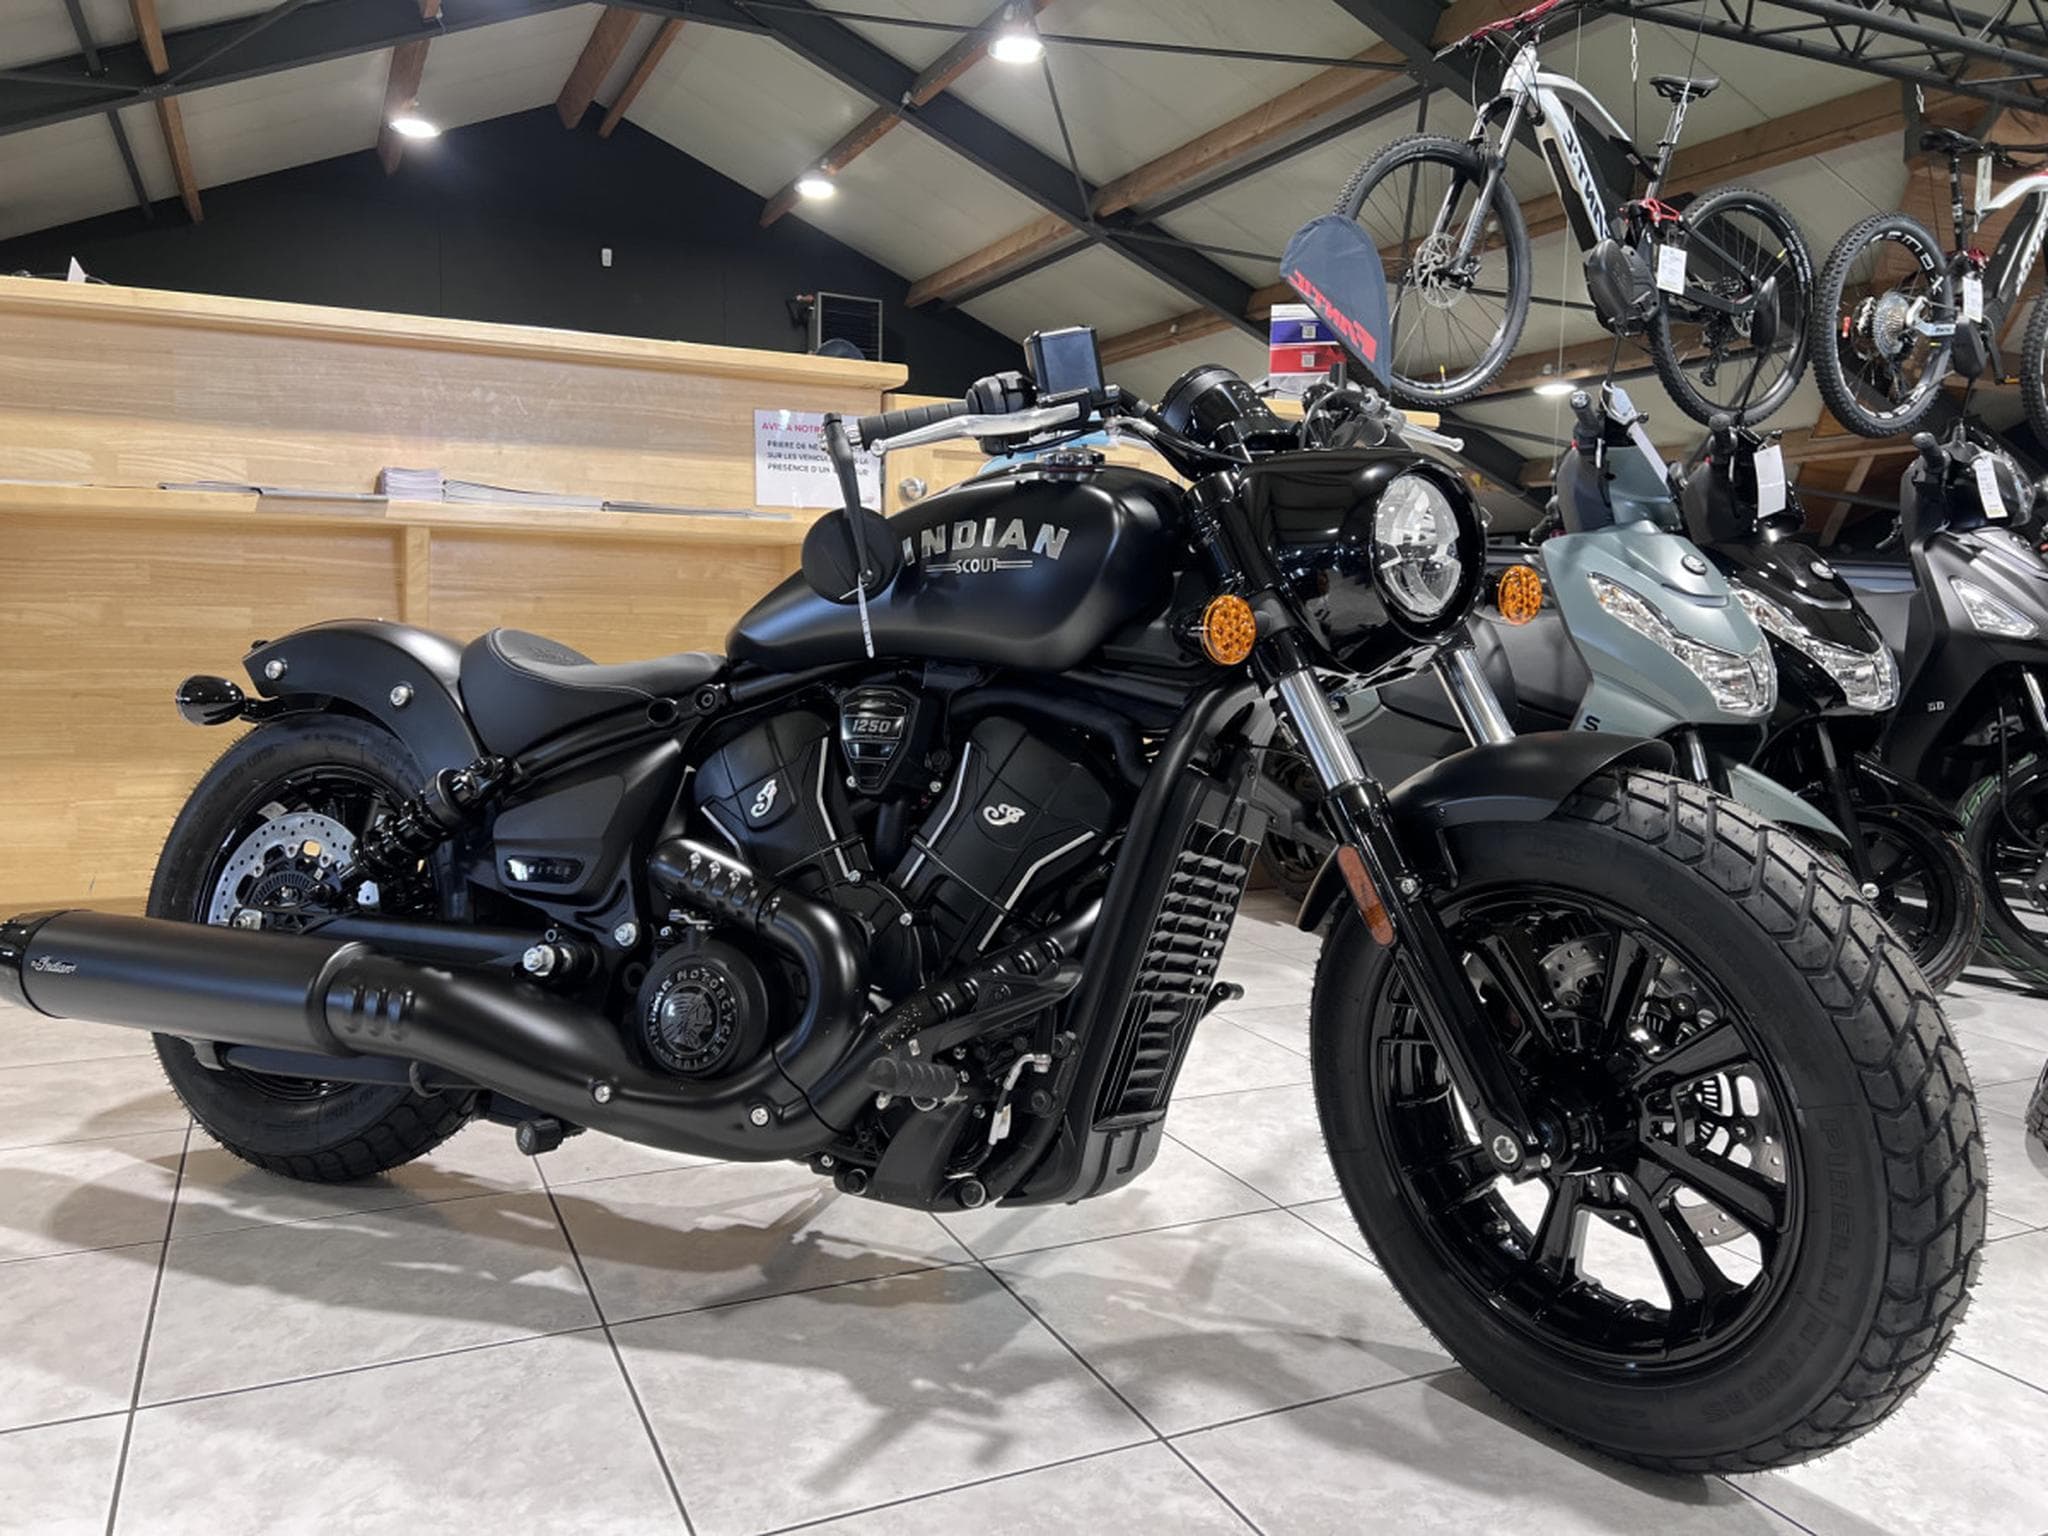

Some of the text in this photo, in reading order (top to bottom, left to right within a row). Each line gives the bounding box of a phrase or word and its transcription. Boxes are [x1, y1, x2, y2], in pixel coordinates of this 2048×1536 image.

[767, 451, 782, 459] SUR
[901, 517, 1069, 566] INDIAN
[955, 558, 998, 573] SCOUT
[852, 719, 891, 733] 1250
